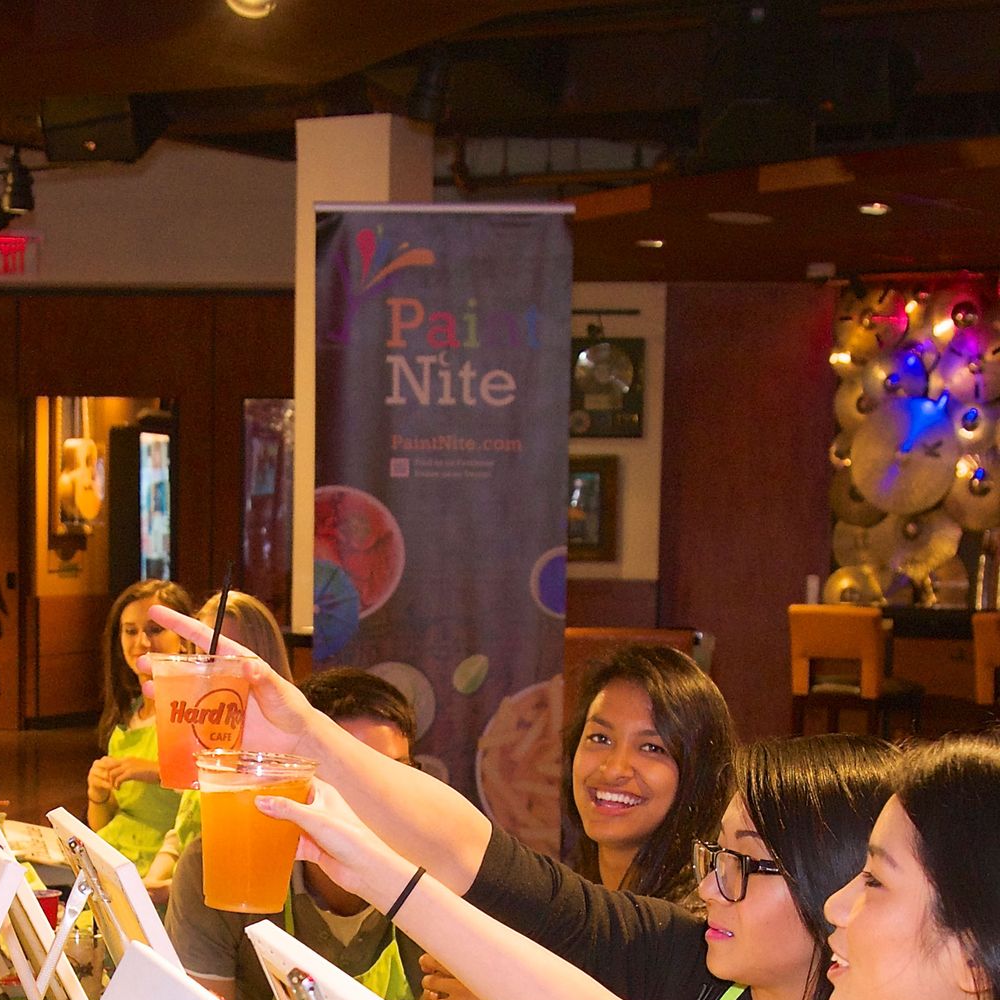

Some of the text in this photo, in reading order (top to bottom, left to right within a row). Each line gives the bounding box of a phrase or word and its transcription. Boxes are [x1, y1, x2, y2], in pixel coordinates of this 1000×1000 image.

[385, 297, 541, 349] Paint
[384, 351, 517, 406] Nite
[391, 434, 522, 452] PaintNite.com
[170, 701, 226, 725] Hard
[209, 732, 232, 742] CAFE
